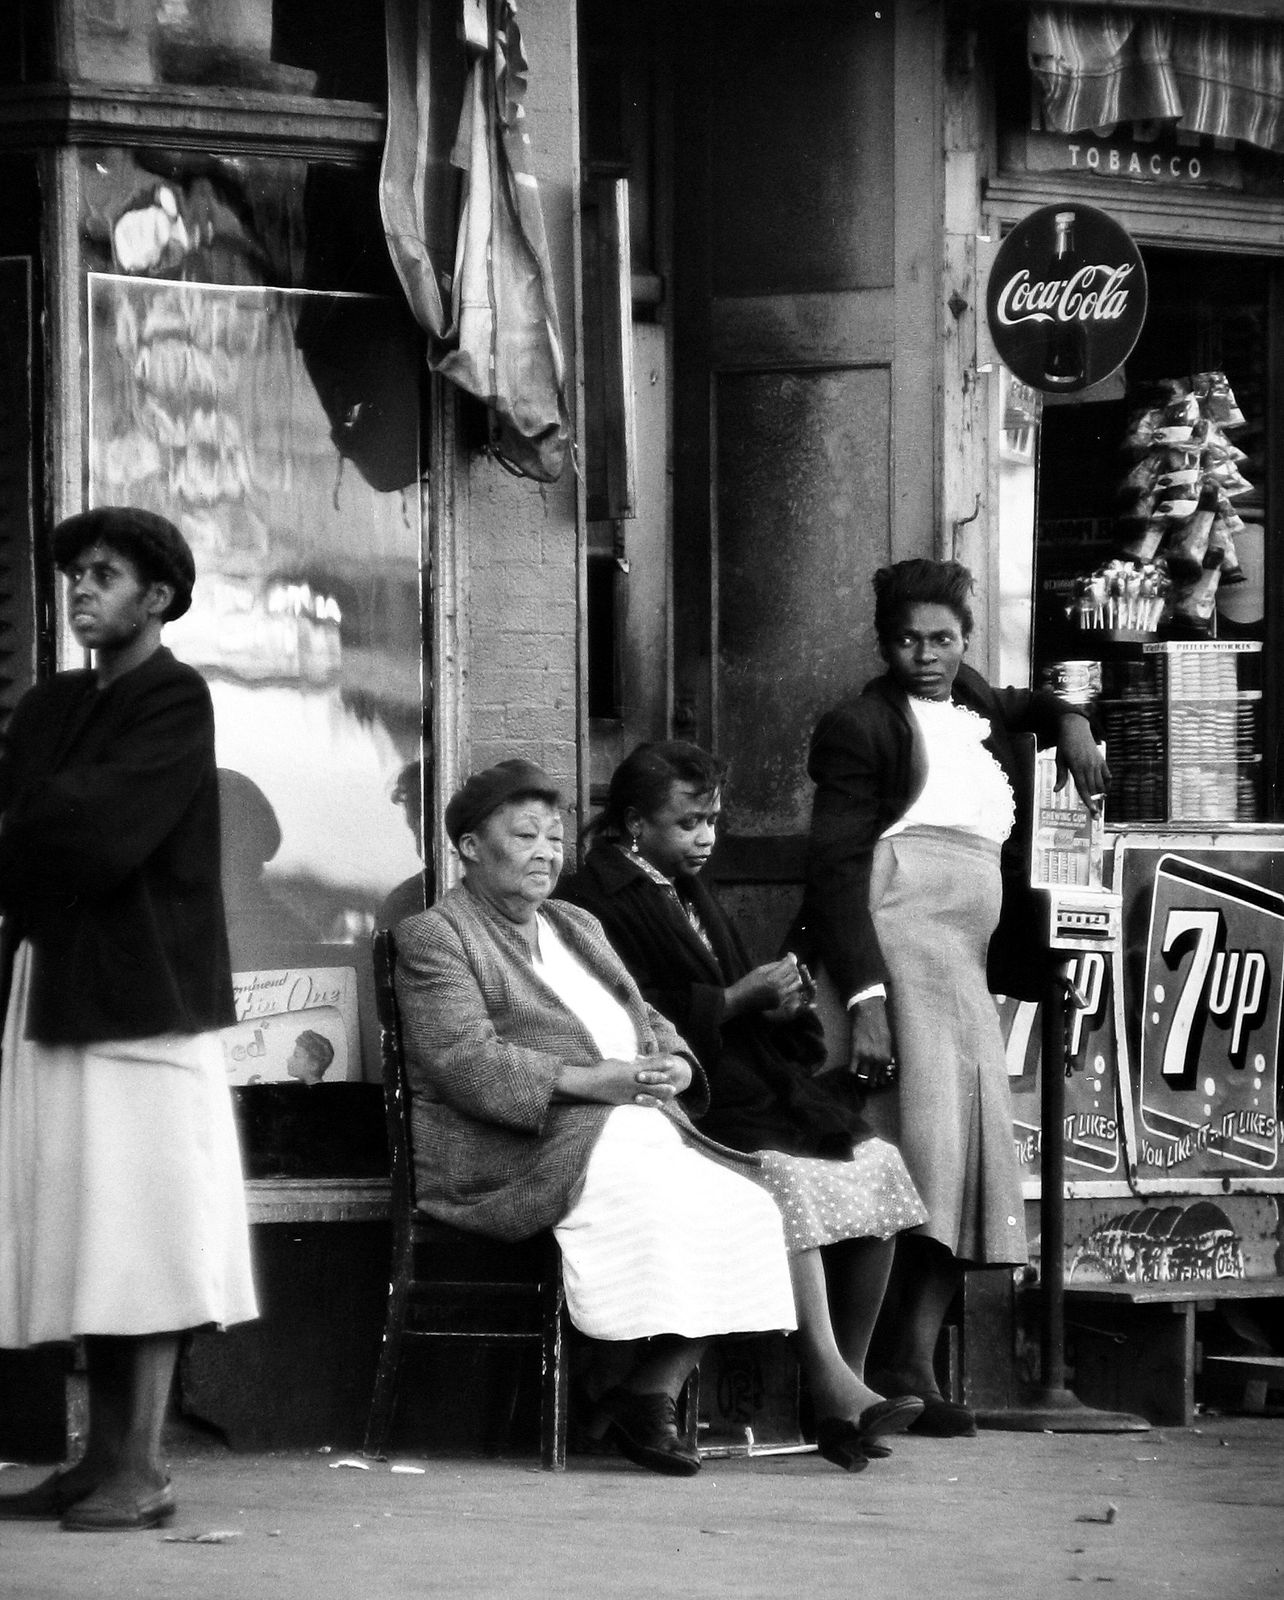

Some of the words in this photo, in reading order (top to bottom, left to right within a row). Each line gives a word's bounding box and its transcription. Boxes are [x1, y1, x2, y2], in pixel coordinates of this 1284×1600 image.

[1068, 144, 1201, 178] TOBACCO
[1212, 643, 1252, 651] MORRIS
[1078, 1113, 1117, 1140] LIKES
[1166, 1132, 1193, 1167] LIKE
[1222, 1112, 1236, 1137] IT
[1239, 1111, 1276, 1137] LIKES
